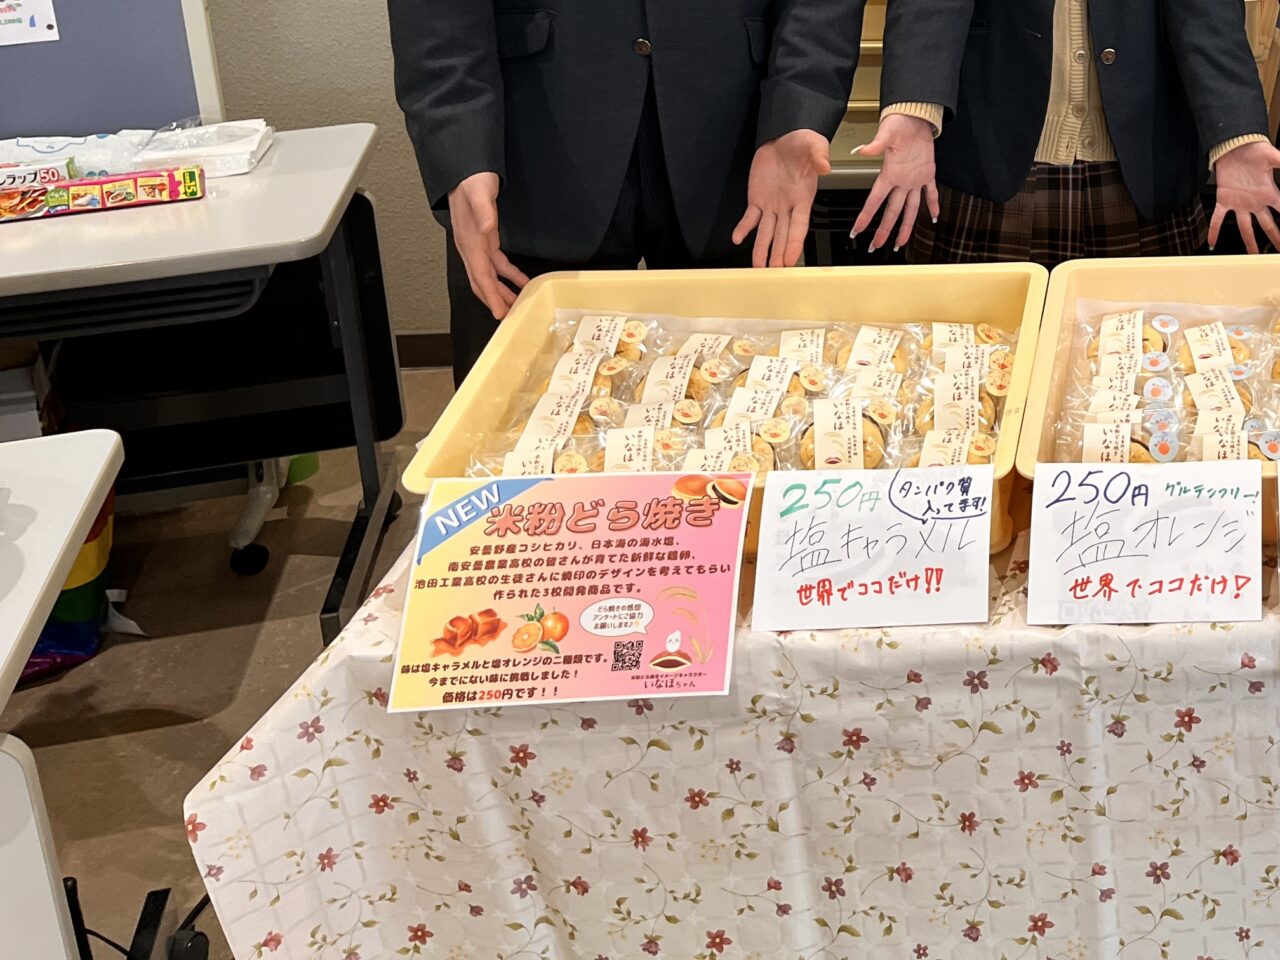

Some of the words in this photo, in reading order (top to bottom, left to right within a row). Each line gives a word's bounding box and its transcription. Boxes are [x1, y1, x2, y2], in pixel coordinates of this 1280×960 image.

[434, 483, 501, 535] NEW
[780, 478, 881, 518] 250円
[899, 476, 973, 499] タンパク質
[1045, 470, 1149, 508] 250円
[484, 496, 722, 538] 米粉どら焼き
[1056, 500, 1255, 575] 塩オレンジ
[779, 516, 977, 577] 塩キャラメル
